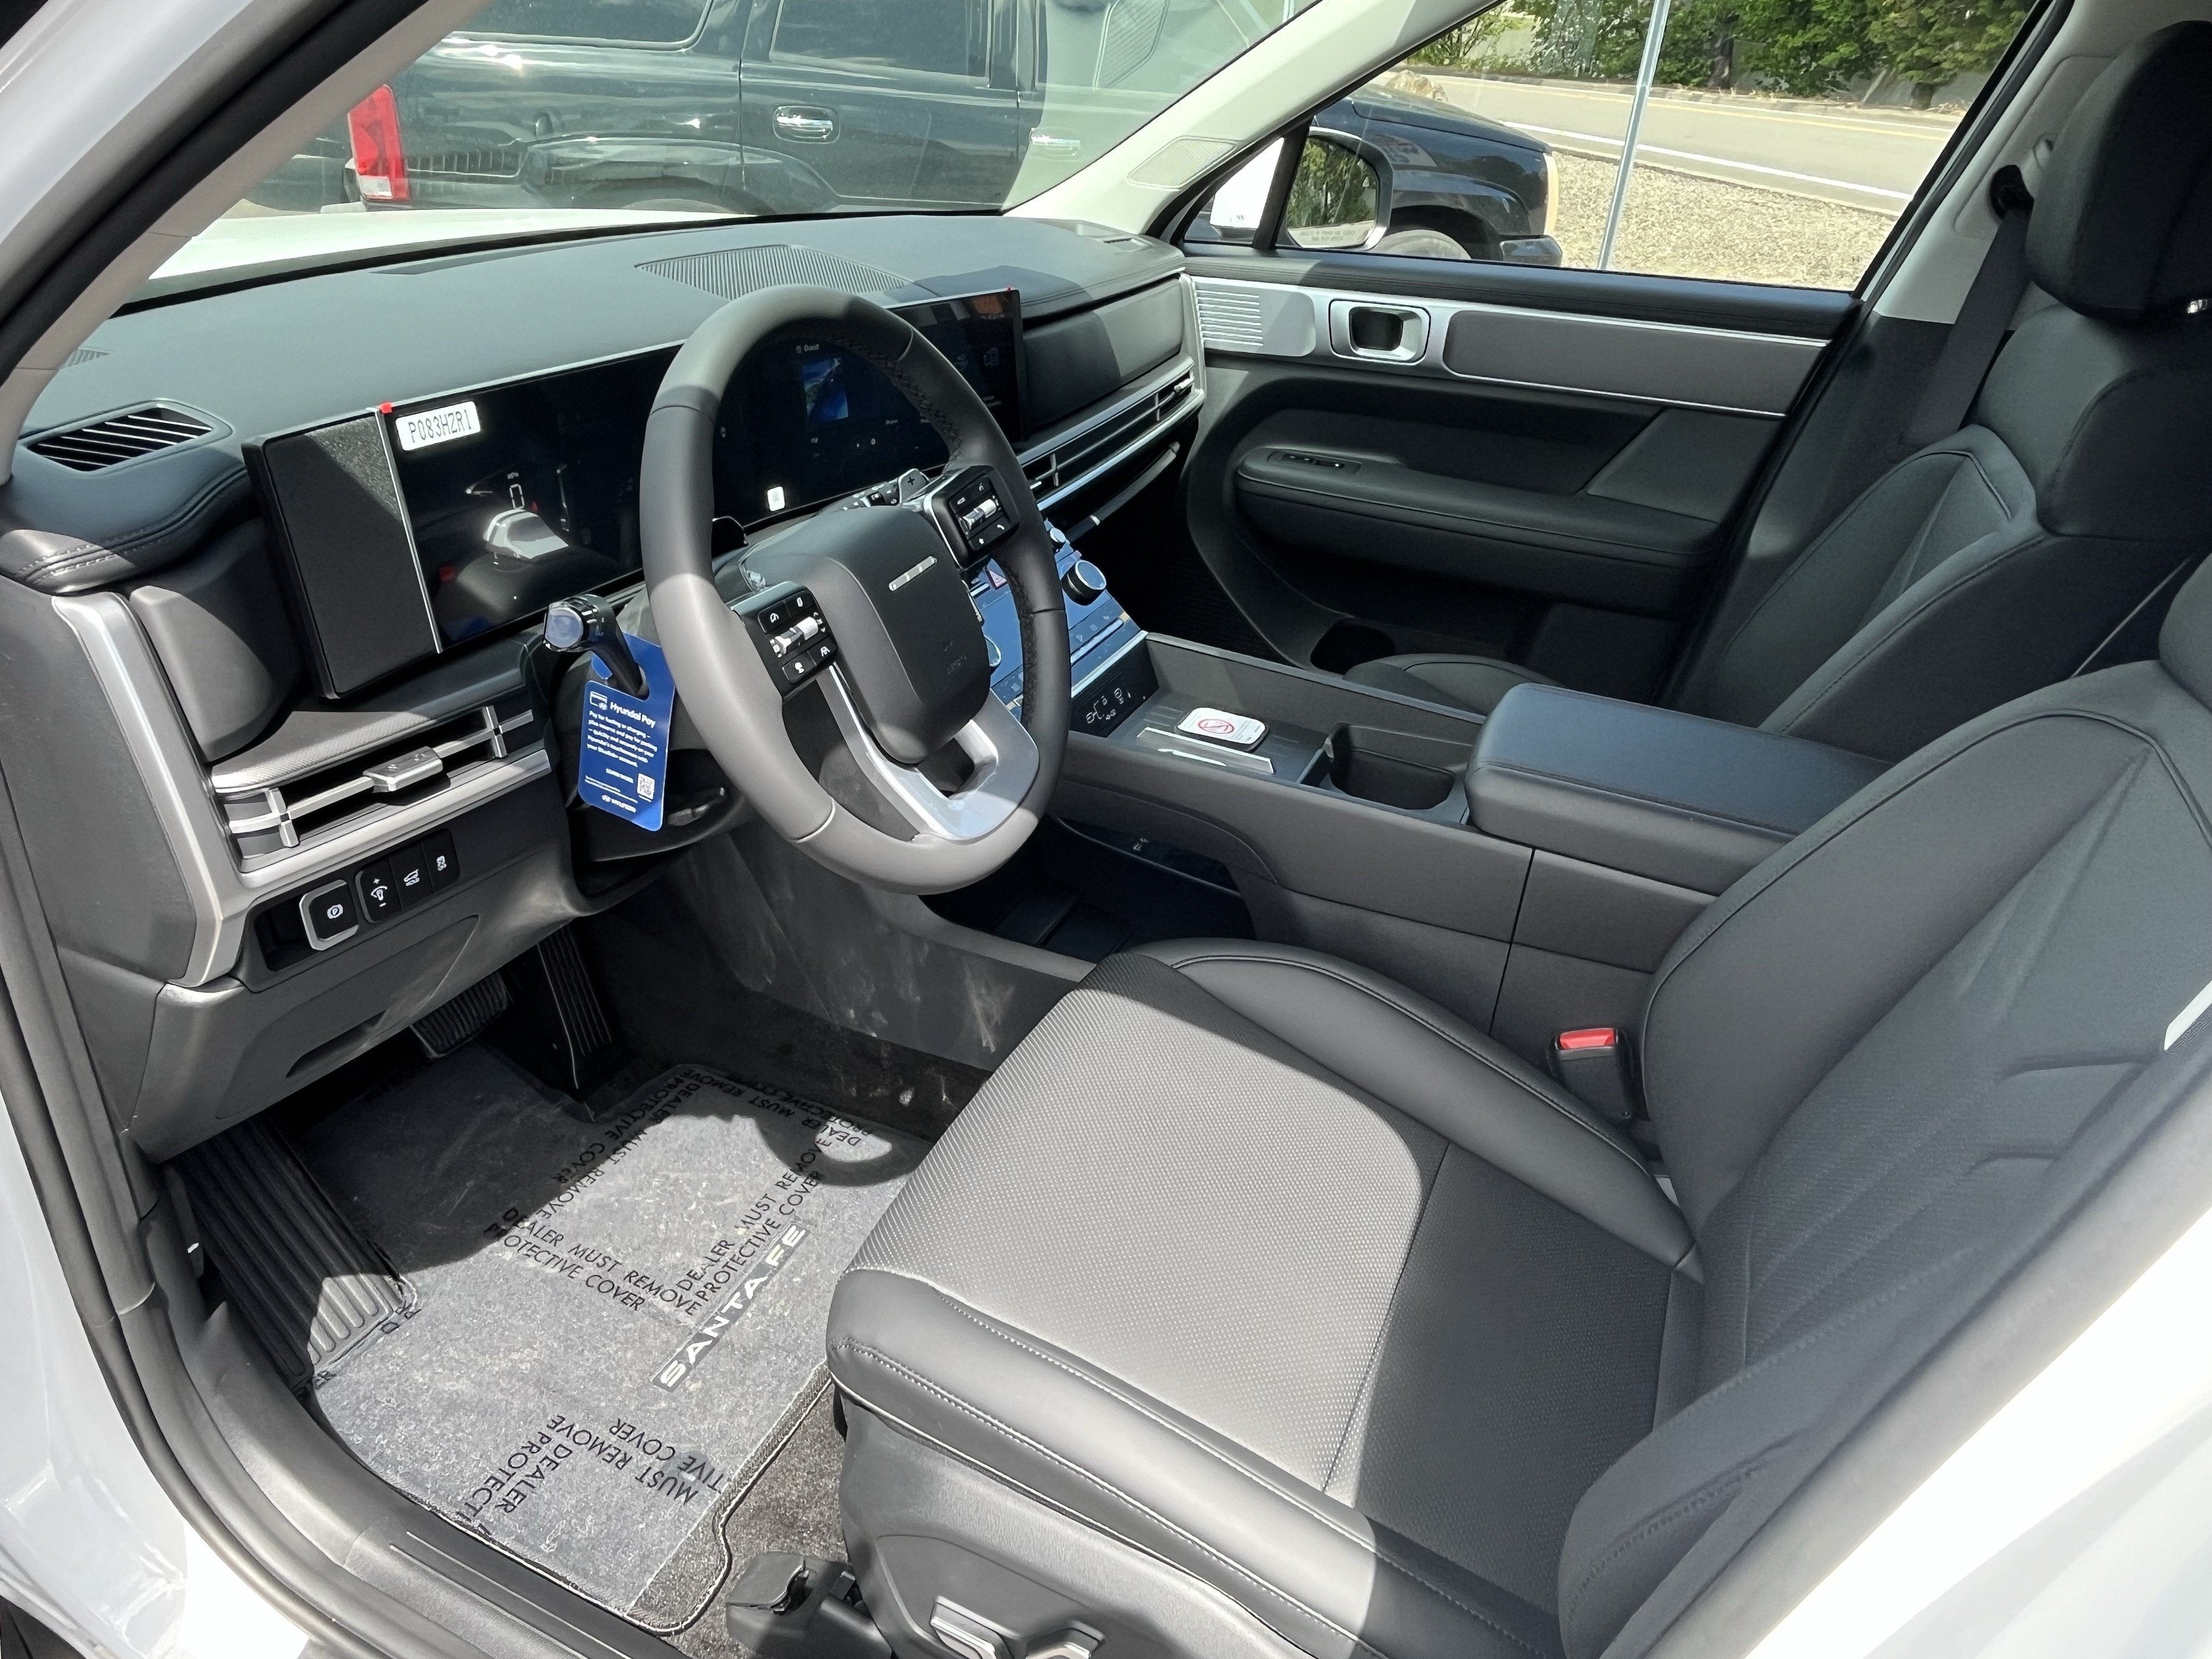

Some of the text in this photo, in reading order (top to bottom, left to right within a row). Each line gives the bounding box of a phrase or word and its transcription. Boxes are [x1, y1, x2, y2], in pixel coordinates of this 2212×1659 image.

[610, 702, 641, 722] Hyundai
[747, 1096, 795, 1118] MUST
[535, 1168, 605, 1220] REMOVE
[551, 1142, 605, 1184] COVER
[675, 1137, 832, 1291] DEALER MUST REMOVE
[695, 1170, 822, 1302] PROTECTIVE COVER
[502, 1206, 703, 1316] DEALER MUST REMOVE
[585, 1274, 646, 1311] COVER
[659, 1224, 806, 1388] SANTA FE
[494, 1443, 573, 1515] DEALER
[546, 1413, 699, 1507] MUST REMOVE
[608, 1418, 731, 1494] TIVE COVER
